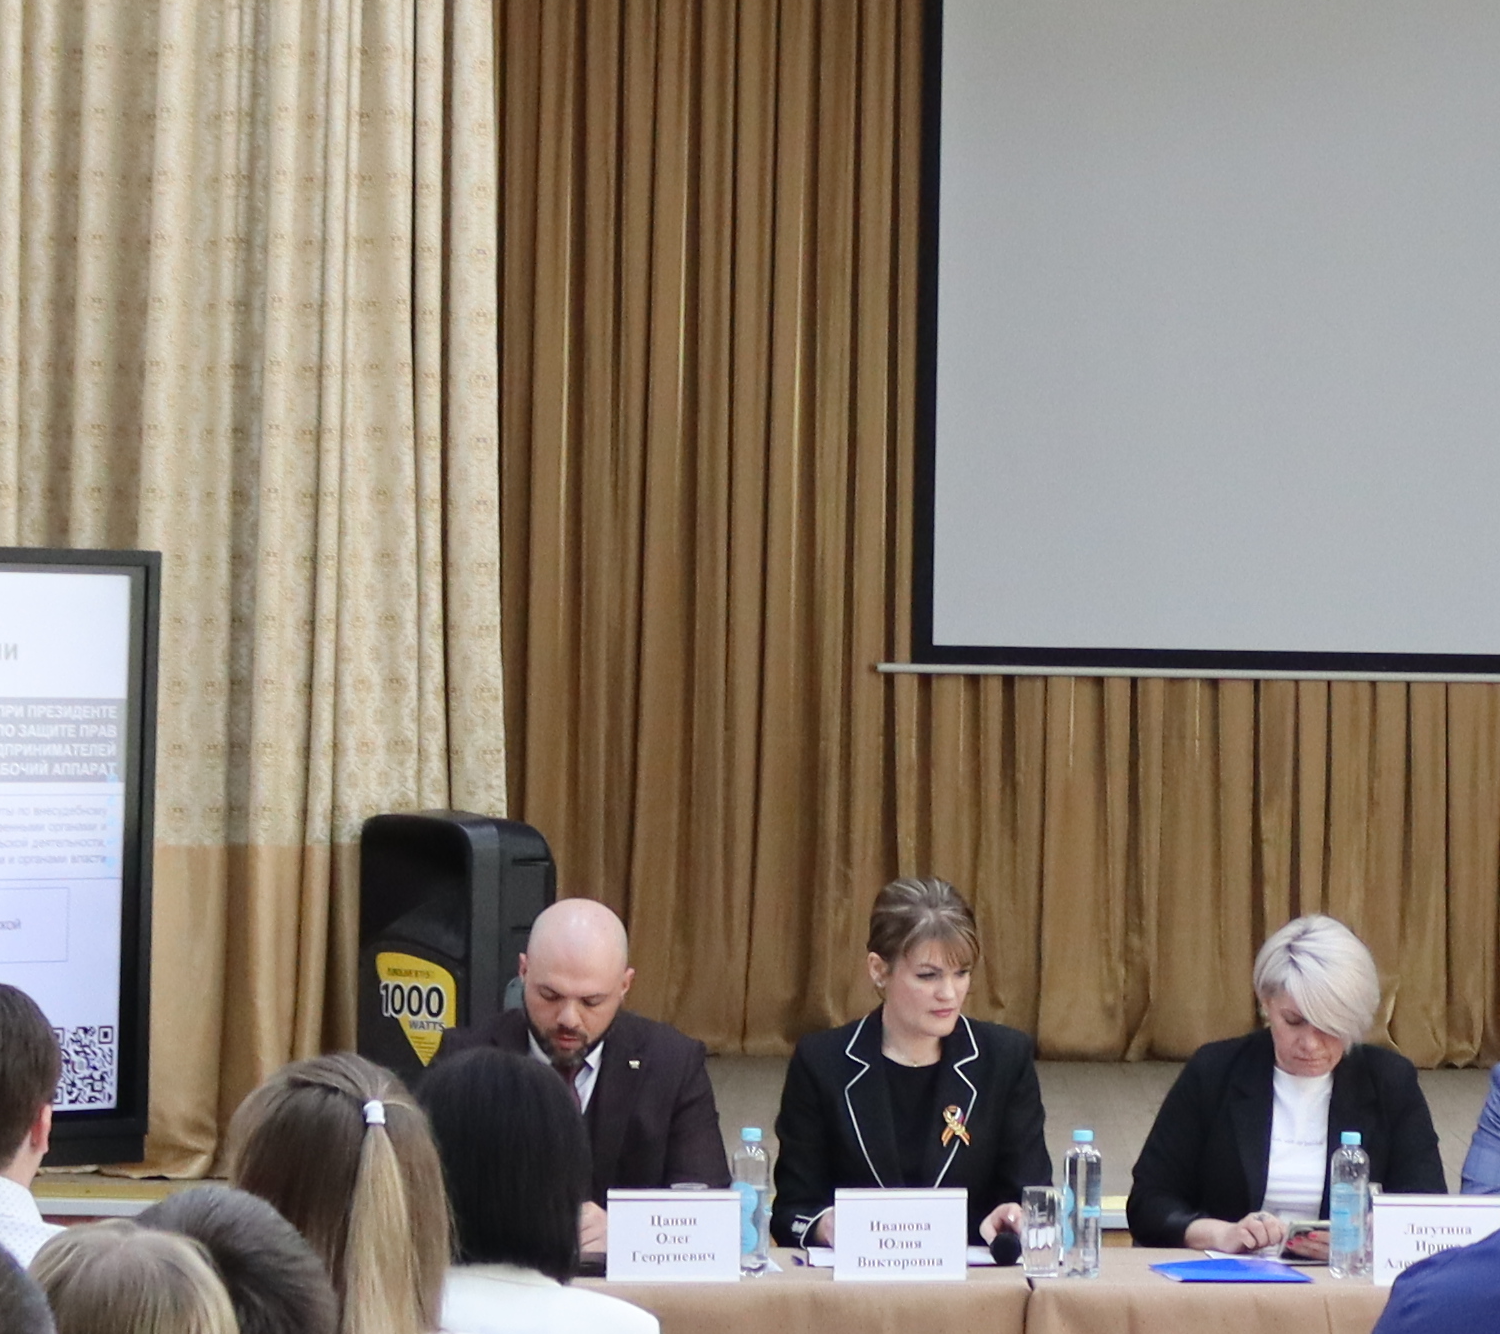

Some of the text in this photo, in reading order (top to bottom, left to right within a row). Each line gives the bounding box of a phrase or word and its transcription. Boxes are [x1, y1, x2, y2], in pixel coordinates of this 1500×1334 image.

[27, 705, 118, 721] ПРЕЗИДЕНТЕ
[18, 724, 77, 740] ЗАЩИТЕ
[79, 724, 118, 738] ПРАВ
[51, 762, 117, 776] АППАРАТ
[381, 982, 445, 1018] 1000
[408, 1020, 445, 1033] WATTS
[869, 1220, 932, 1233] Иванова
[1404, 1223, 1473, 1238] Лагутина
[656, 1232, 691, 1246] Олег
[878, 1237, 923, 1250] Юлия
[630, 1250, 716, 1266] Георгиевич
[857, 1255, 944, 1270] Викторовна
